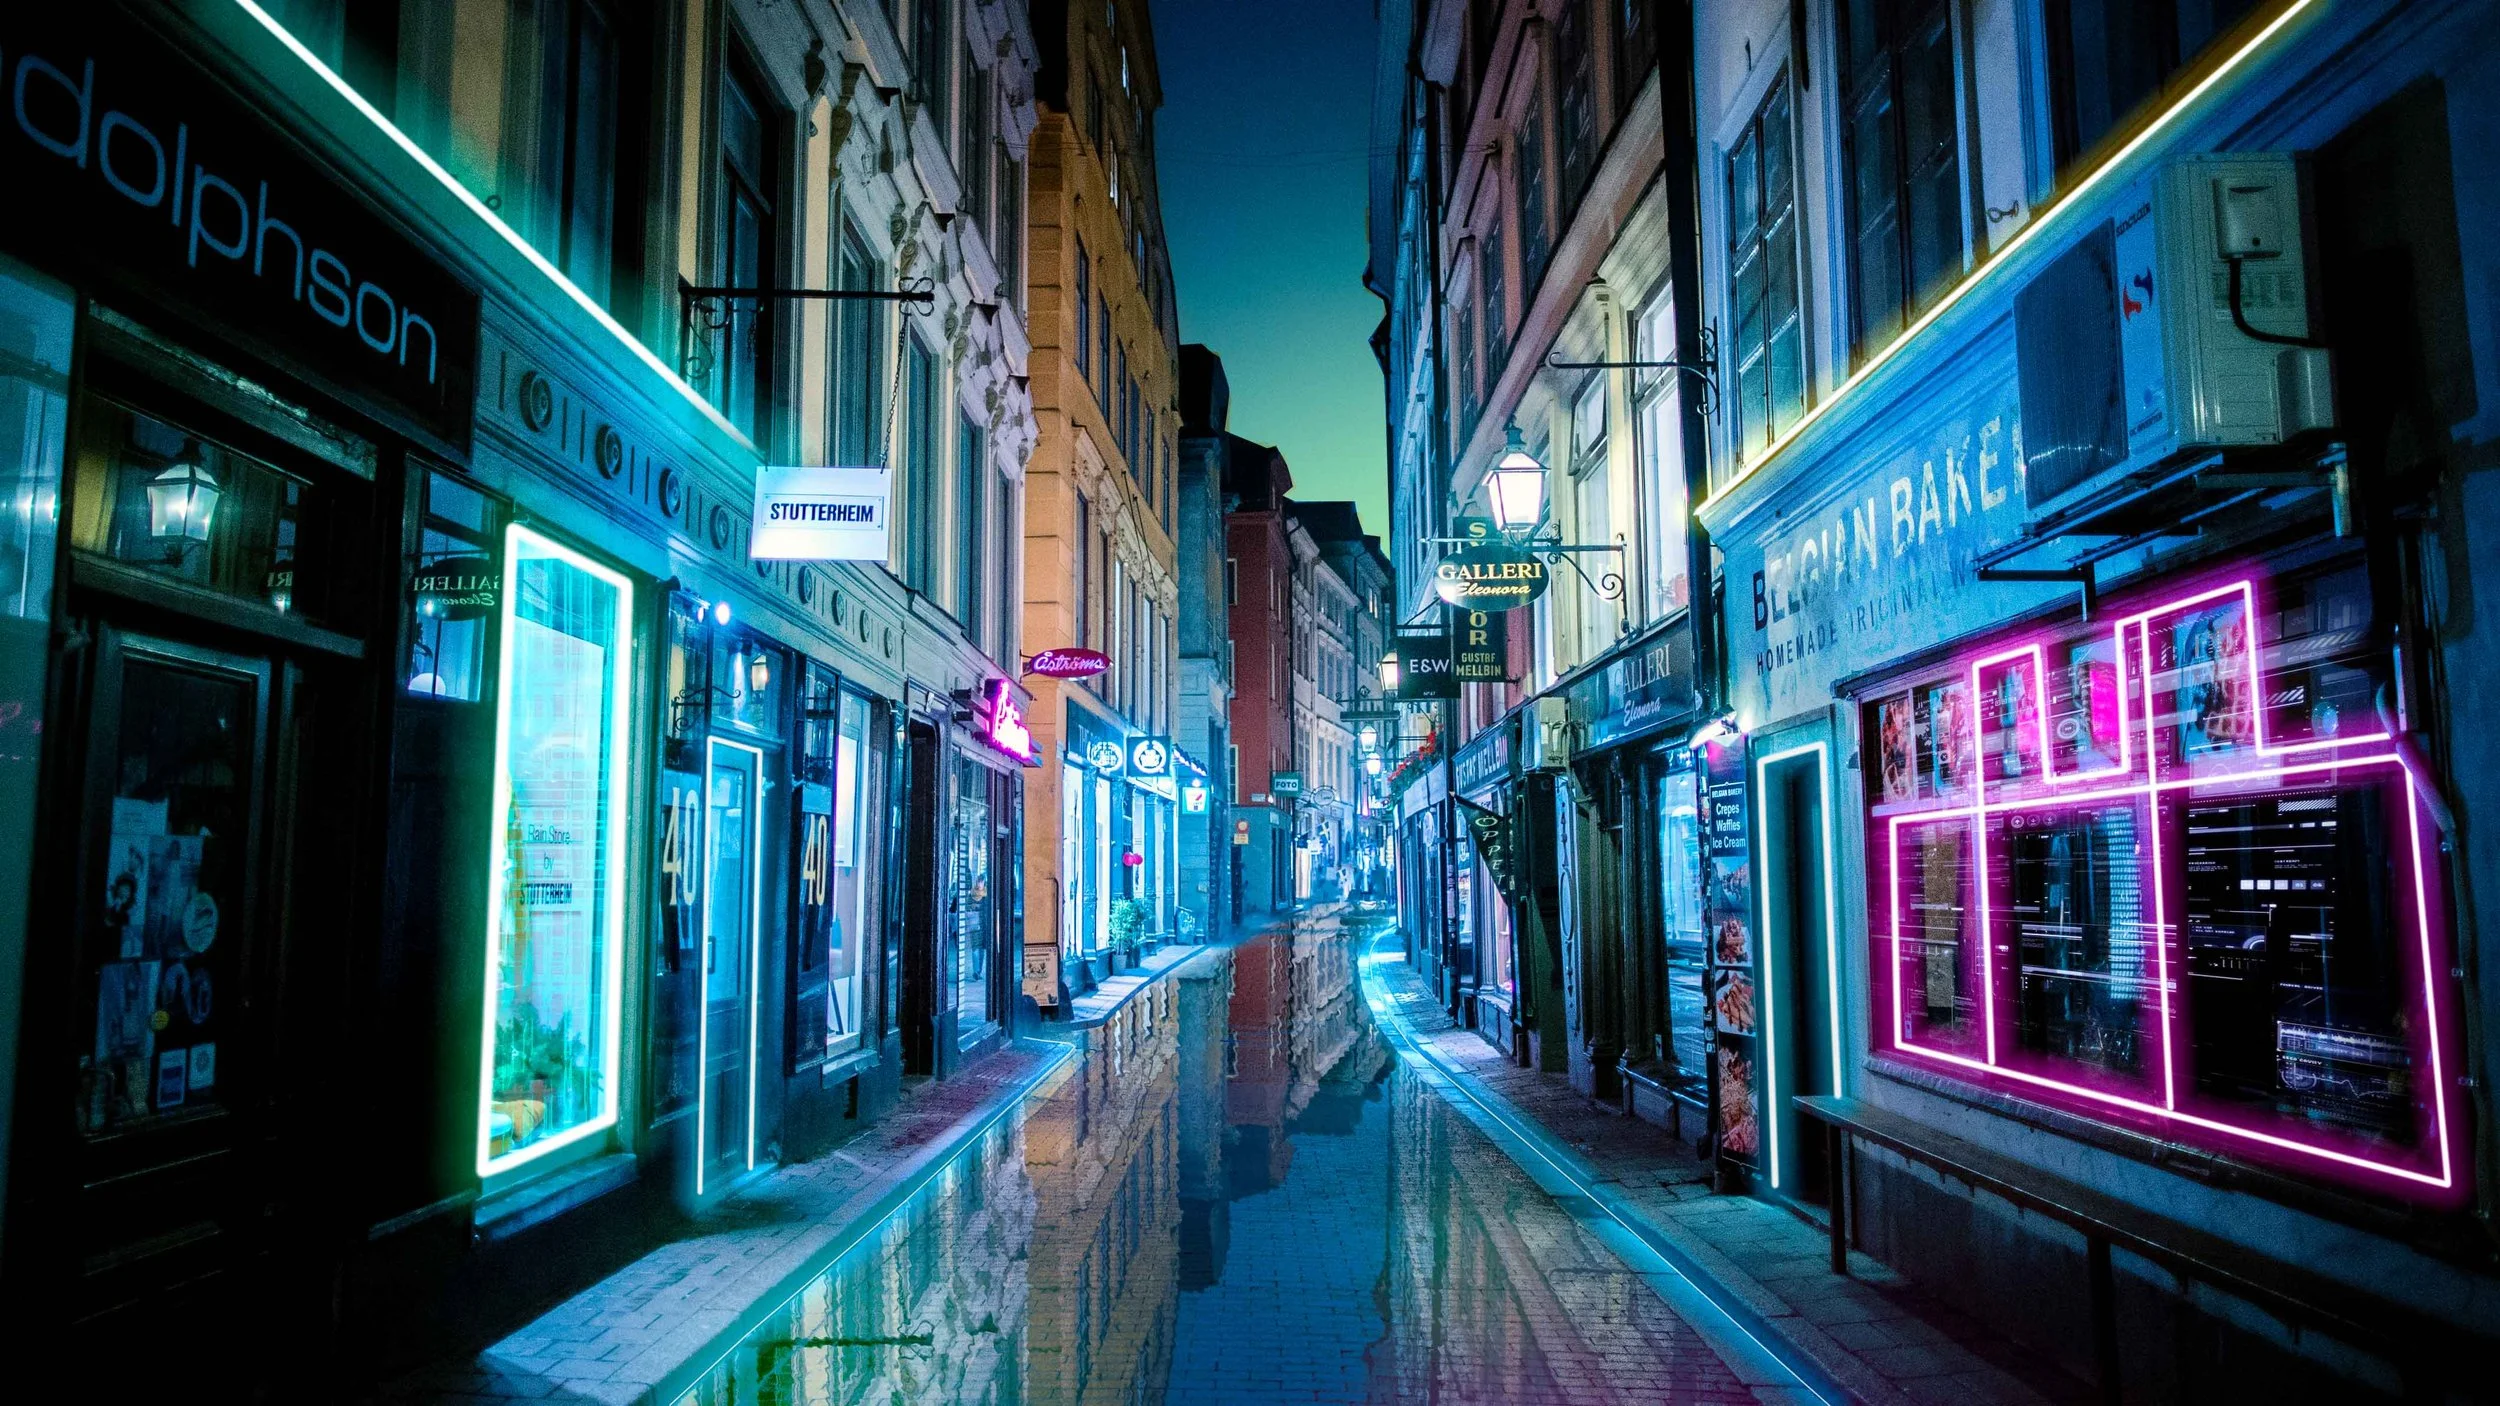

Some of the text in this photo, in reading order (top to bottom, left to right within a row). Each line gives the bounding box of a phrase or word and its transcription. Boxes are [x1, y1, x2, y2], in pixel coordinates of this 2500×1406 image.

[0, 44, 437, 384] dolphson
[770, 503, 874, 524] STUTTERHEIM
[1438, 563, 1542, 580] GALLERI
[1753, 497, 1877, 631] BELGIAN
[1455, 582, 1531, 597] Eleonora
[1757, 620, 1837, 675] HOMEMADE
[1410, 659, 1449, 673] E&W
[1456, 664, 1501, 676] MELLBIN
[1624, 696, 1662, 727] Eleonora
[1712, 788, 1743, 798] BELGIAN BAKERY
[1716, 803, 1740, 817] Crepes
[528, 824, 570, 845] Rain Store
[1716, 819, 1740, 831] Waffles
[662, 787, 698, 906] 40
[1475, 815, 1506, 885] ÖPPET
[1723, 836, 1745, 848] Cream
[543, 850, 554, 873] by
[803, 814, 827, 906] 40
[520, 883, 572, 905] STUTTERHEIM
